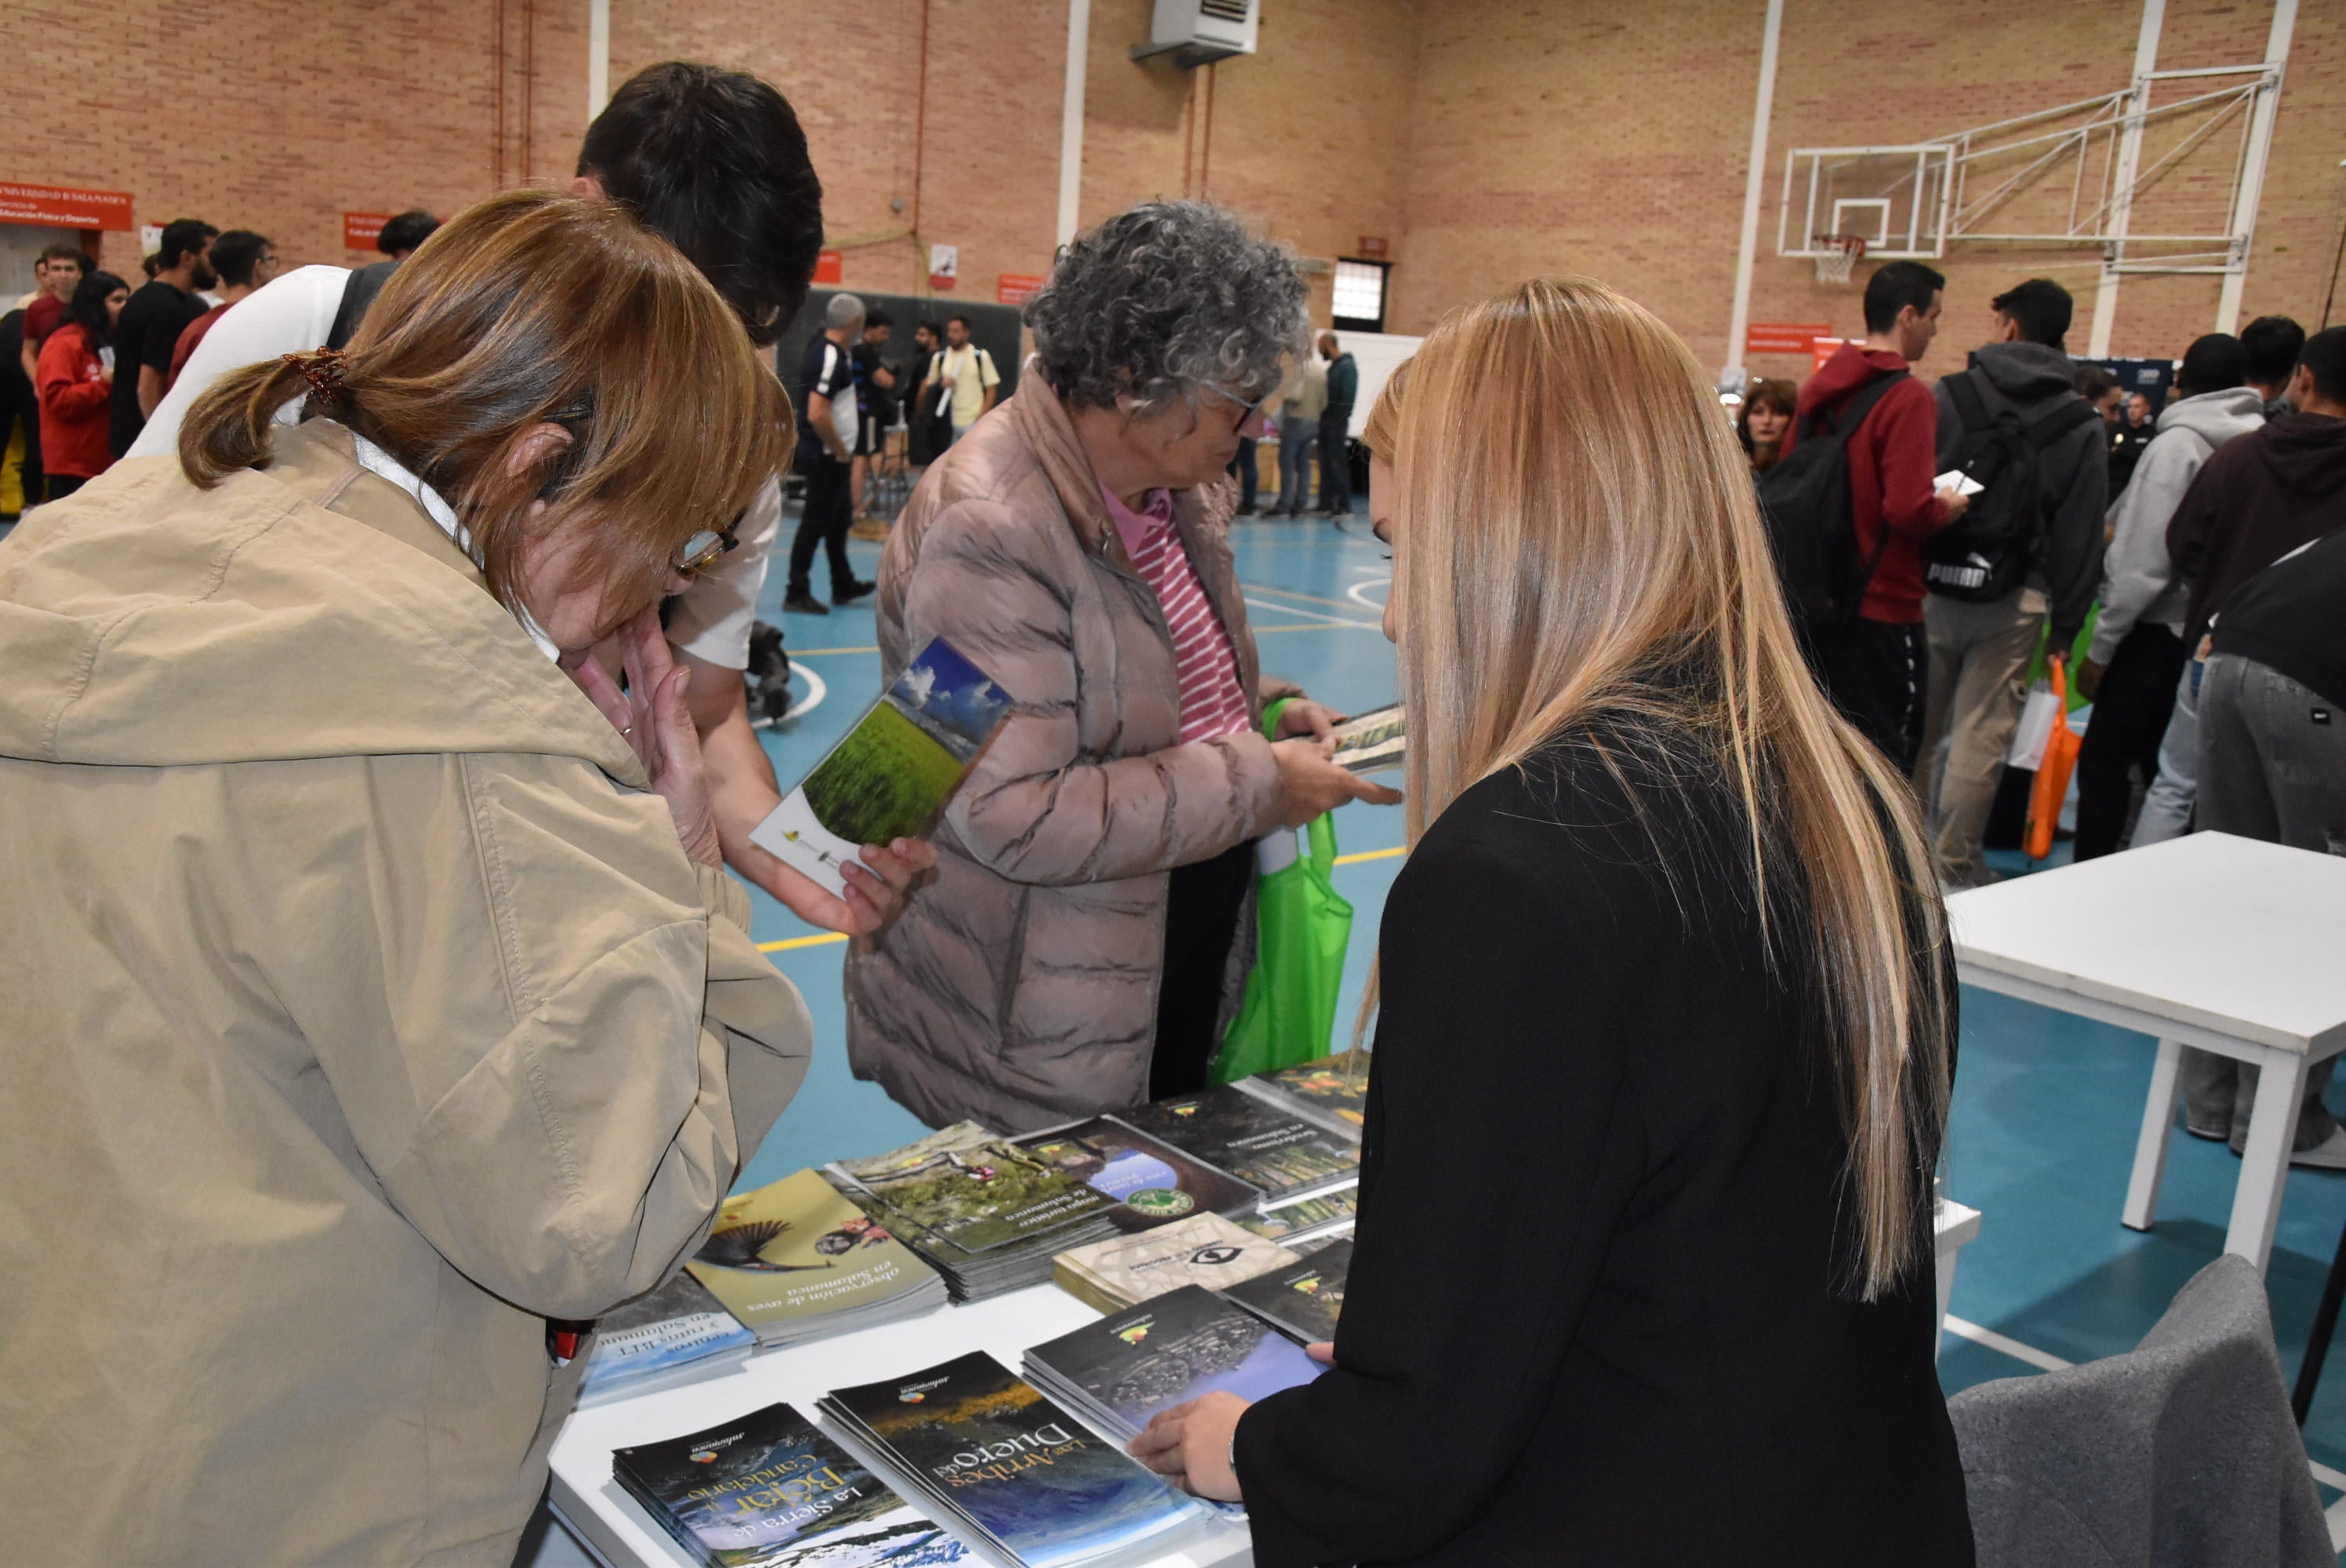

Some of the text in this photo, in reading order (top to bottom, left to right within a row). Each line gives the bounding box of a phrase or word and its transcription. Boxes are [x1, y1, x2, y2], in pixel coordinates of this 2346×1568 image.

[747, 1267, 899, 1312] observación de aves
[786, 1261, 892, 1297] en Salamanca
[692, 1432, 745, 1453] salamanca
[932, 1422, 1074, 1478] del Duero
[687, 1454, 817, 1500] Candelario
[945, 1447, 1055, 1487] Arribes
[733, 1486, 863, 1538] La Sierra de
[735, 1466, 847, 1515] Béjar
